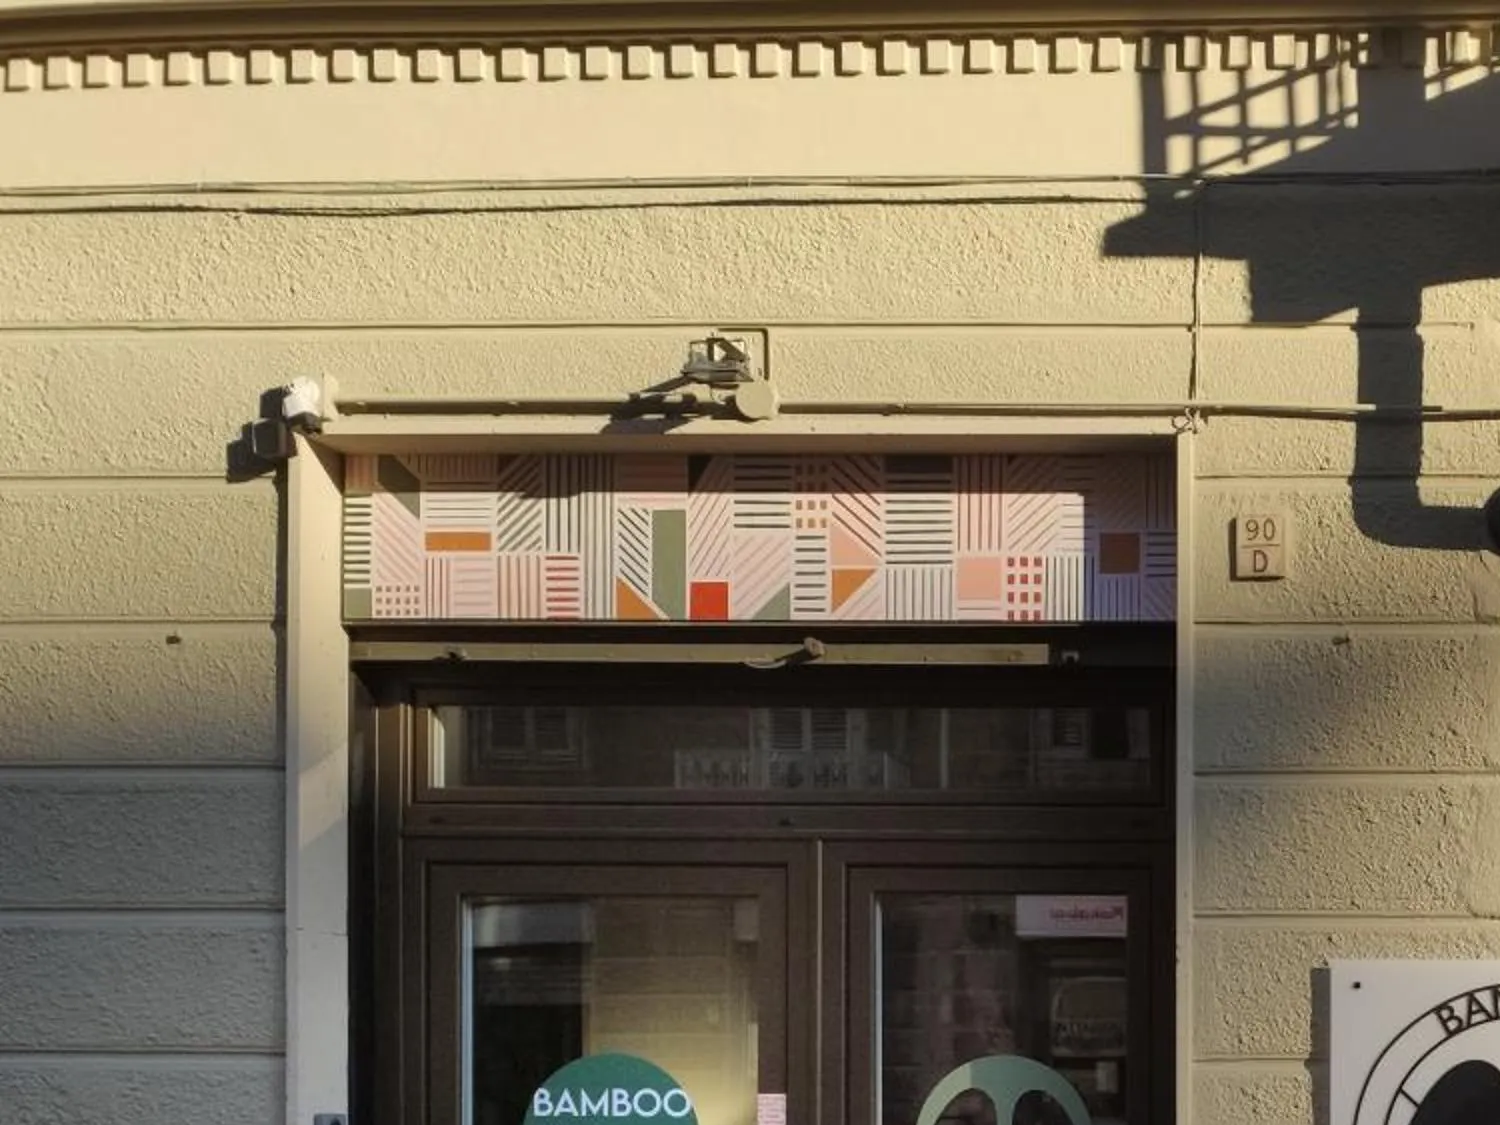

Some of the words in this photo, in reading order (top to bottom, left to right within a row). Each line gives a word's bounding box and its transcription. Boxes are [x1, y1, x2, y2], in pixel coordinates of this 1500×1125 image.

[1245, 518, 1276, 541] 90
[1253, 549, 1268, 573] D
[533, 1087, 692, 1118] BAMBOO
